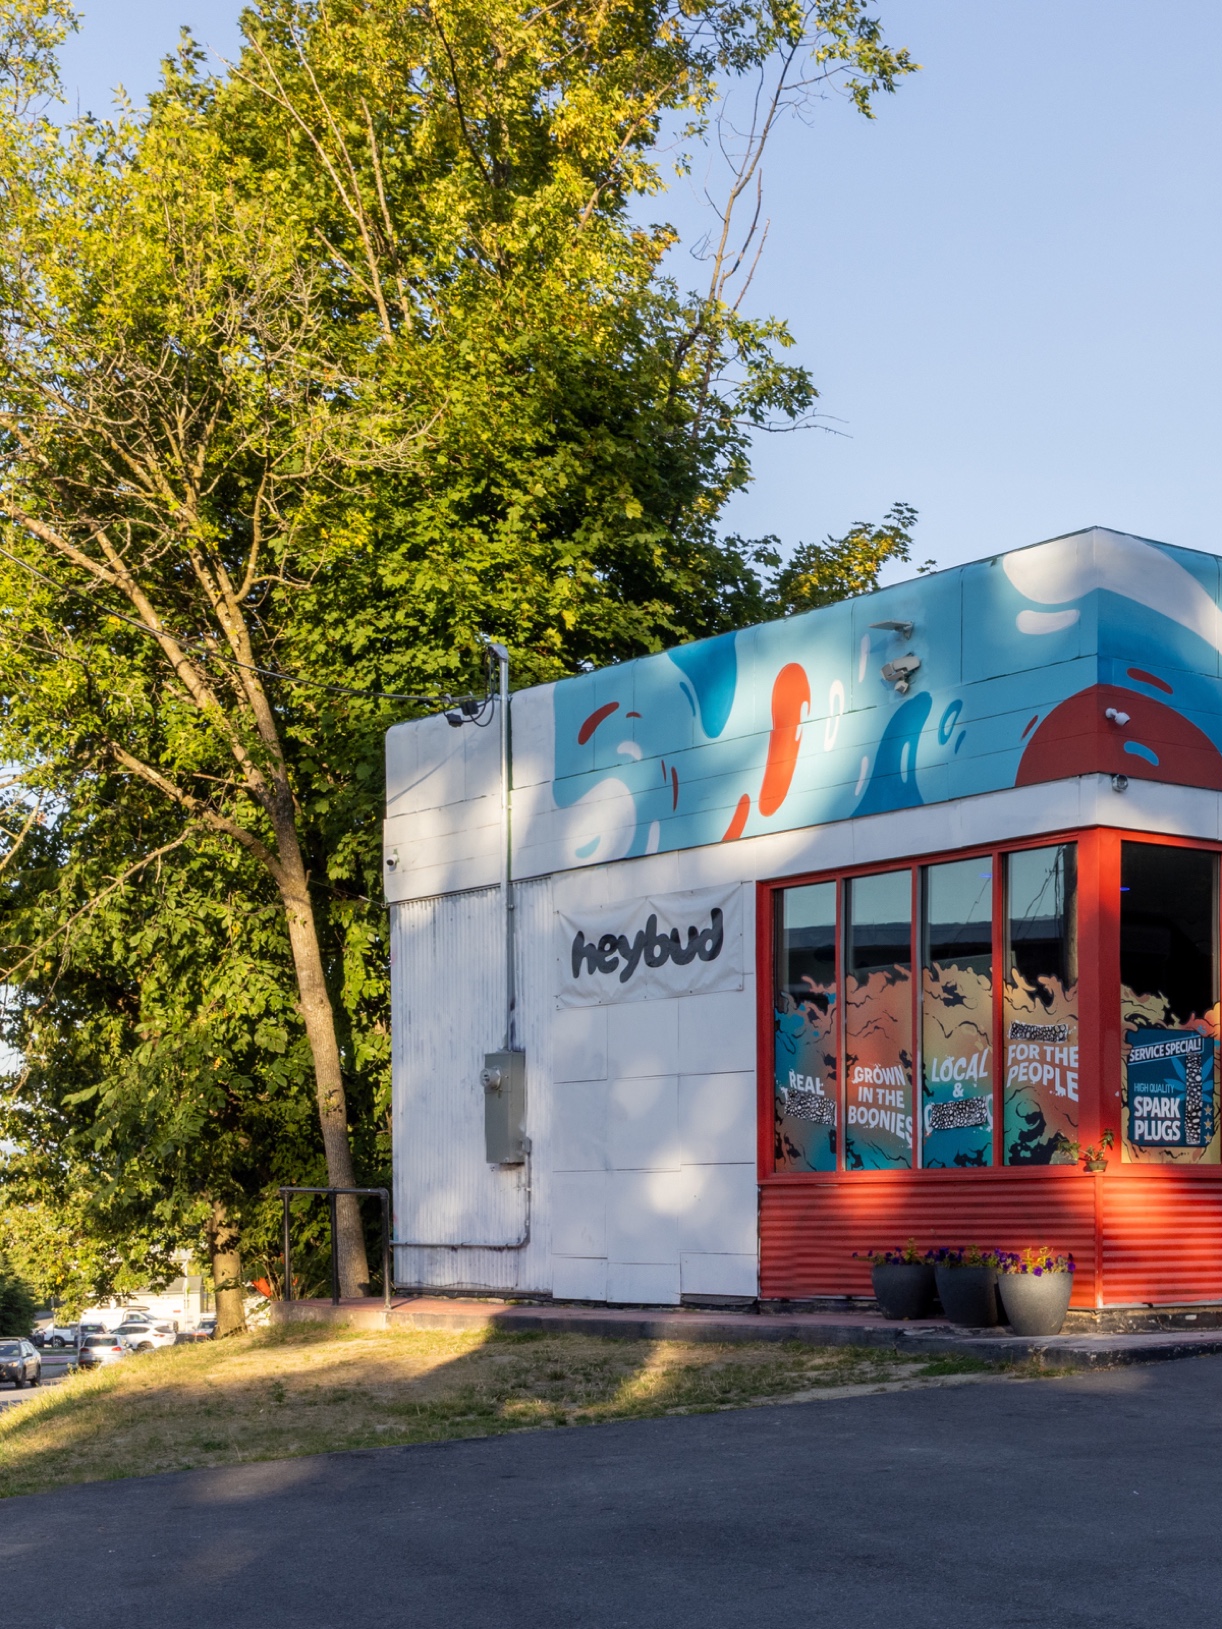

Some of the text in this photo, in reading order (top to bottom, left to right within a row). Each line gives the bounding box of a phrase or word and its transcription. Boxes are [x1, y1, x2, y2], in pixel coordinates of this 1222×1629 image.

[571, 907, 724, 984] heybud
[1007, 1044, 1079, 1068] FOR THE
[1129, 1038, 1201, 1062] SERVICE SPECIAL!
[852, 1064, 906, 1086] GROWN
[931, 1048, 988, 1083] LOCAL
[788, 1068, 825, 1096] REAL
[952, 1082, 964, 1098] &
[1006, 1061, 1079, 1103] PEOPLE
[1134, 1082, 1175, 1093] HIGH QUALITY
[858, 1086, 905, 1109] IN THE
[1133, 1096, 1181, 1118] SPARK
[848, 1105, 912, 1148] BOONIES
[1134, 1120, 1181, 1141] PLUGS
